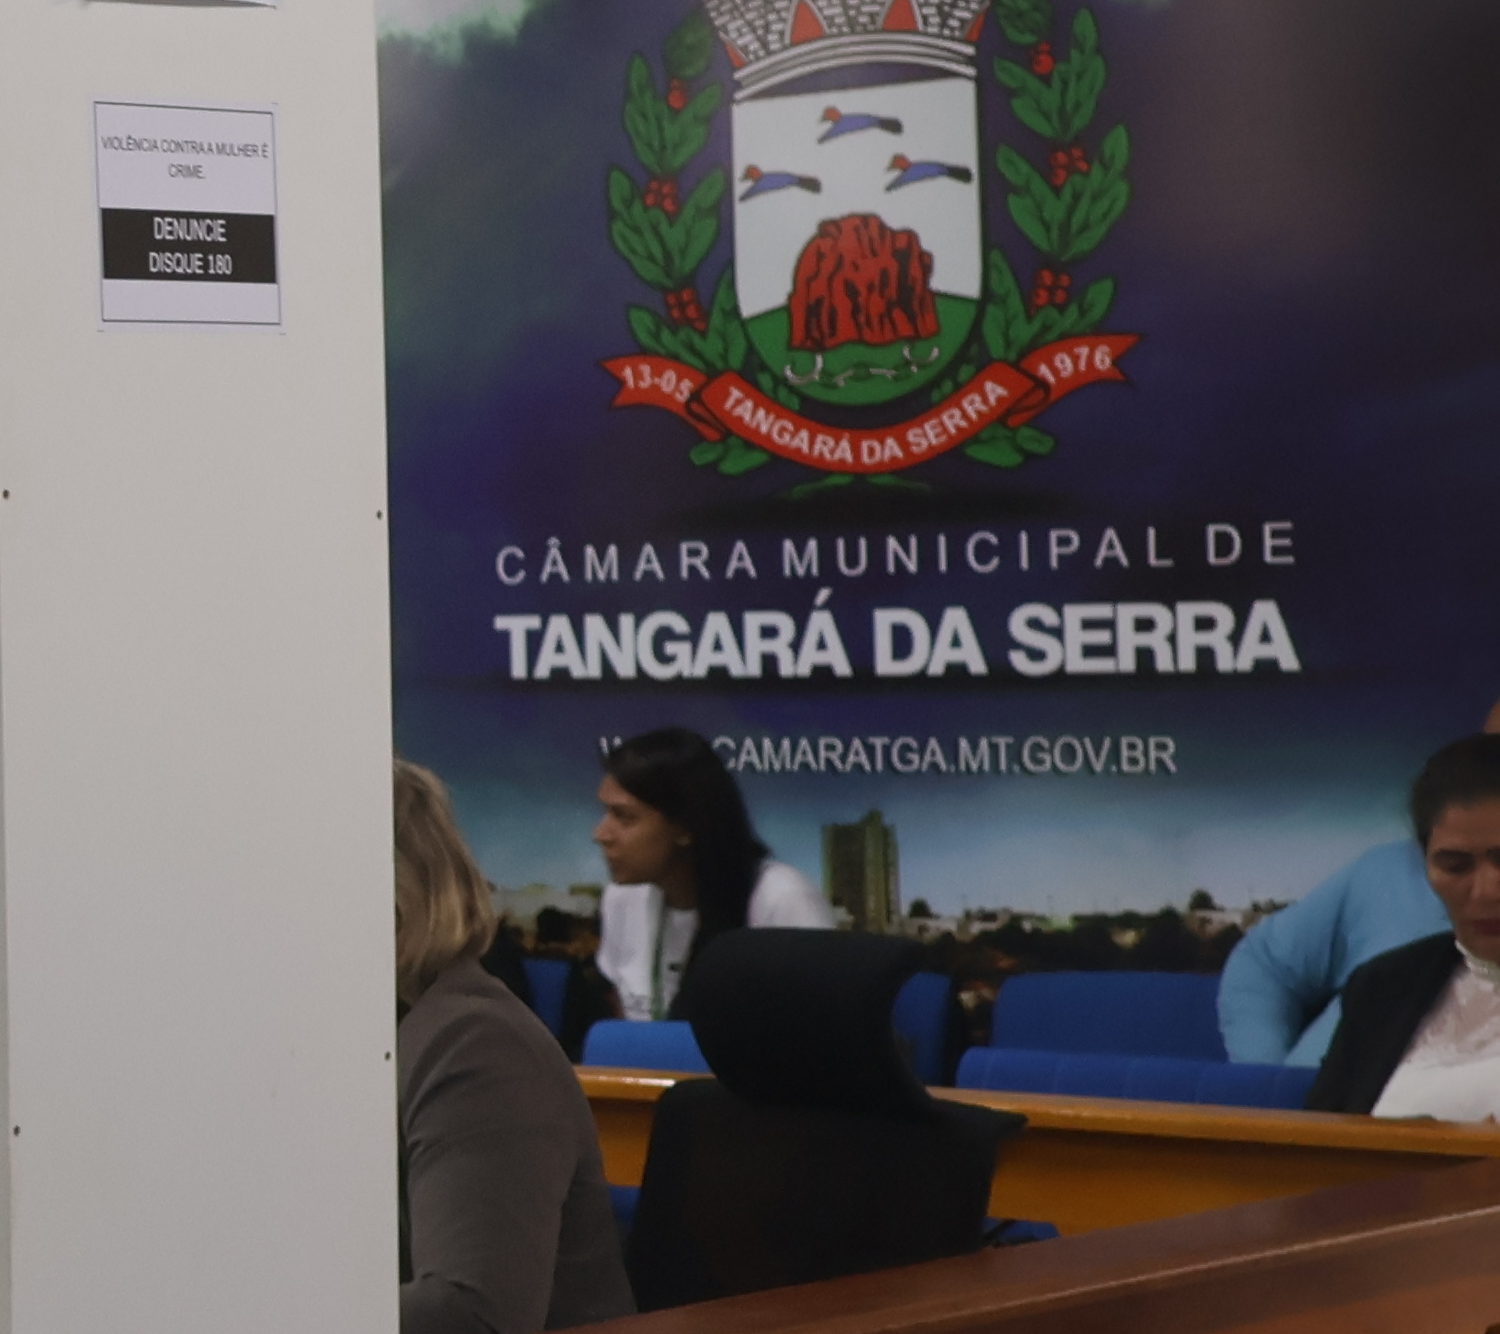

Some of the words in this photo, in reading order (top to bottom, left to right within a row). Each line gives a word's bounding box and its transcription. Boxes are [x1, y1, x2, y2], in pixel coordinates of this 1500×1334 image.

[101, 134, 159, 152] VIOLÊNCIA
[161, 140, 203, 154] CONTRA
[215, 143, 259, 157] MULHER
[153, 217, 227, 242] DENUNCIE
[149, 252, 204, 274] DISQUE
[208, 254, 233, 275] 180
[621, 361, 693, 402] 13-05
[1037, 344, 1114, 386] 1976
[722, 385, 854, 465] TANGARÁ
[861, 437, 904, 466] DA
[905, 379, 1008, 454] SERRA
[495, 536, 757, 586] CÂMARA
[782, 526, 1175, 579] MUNICIPAL
[1206, 520, 1295, 567] DE
[493, 586, 854, 681] TANGARÁ
[873, 605, 989, 678] DA
[1007, 599, 1302, 678] SERRA
